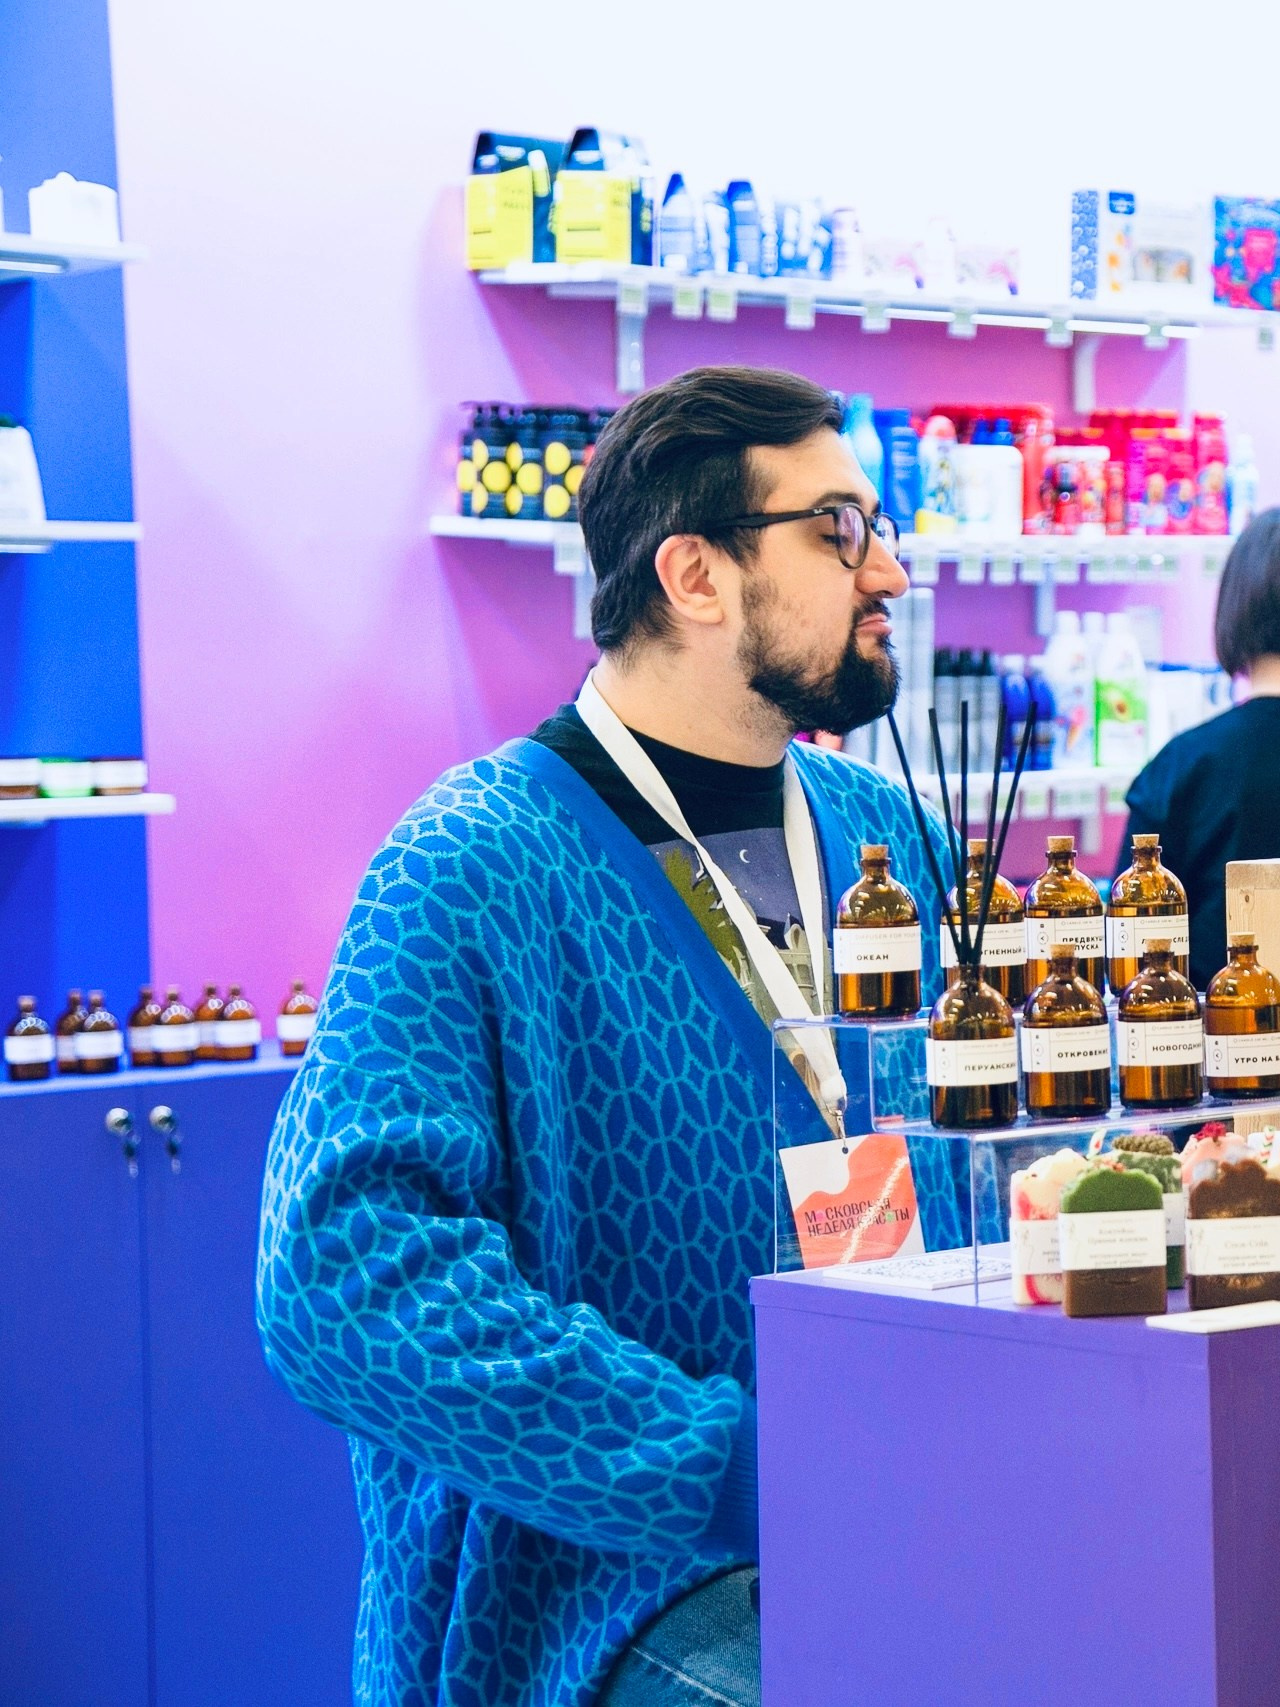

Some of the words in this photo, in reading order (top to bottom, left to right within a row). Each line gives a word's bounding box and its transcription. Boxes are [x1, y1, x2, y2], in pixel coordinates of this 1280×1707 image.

[981, 946, 1022, 955] ГНЕННЫЙ
[805, 1197, 891, 1224] МОСКОВСЯ
[808, 1217, 855, 1237] НЕДЕЛЯ
